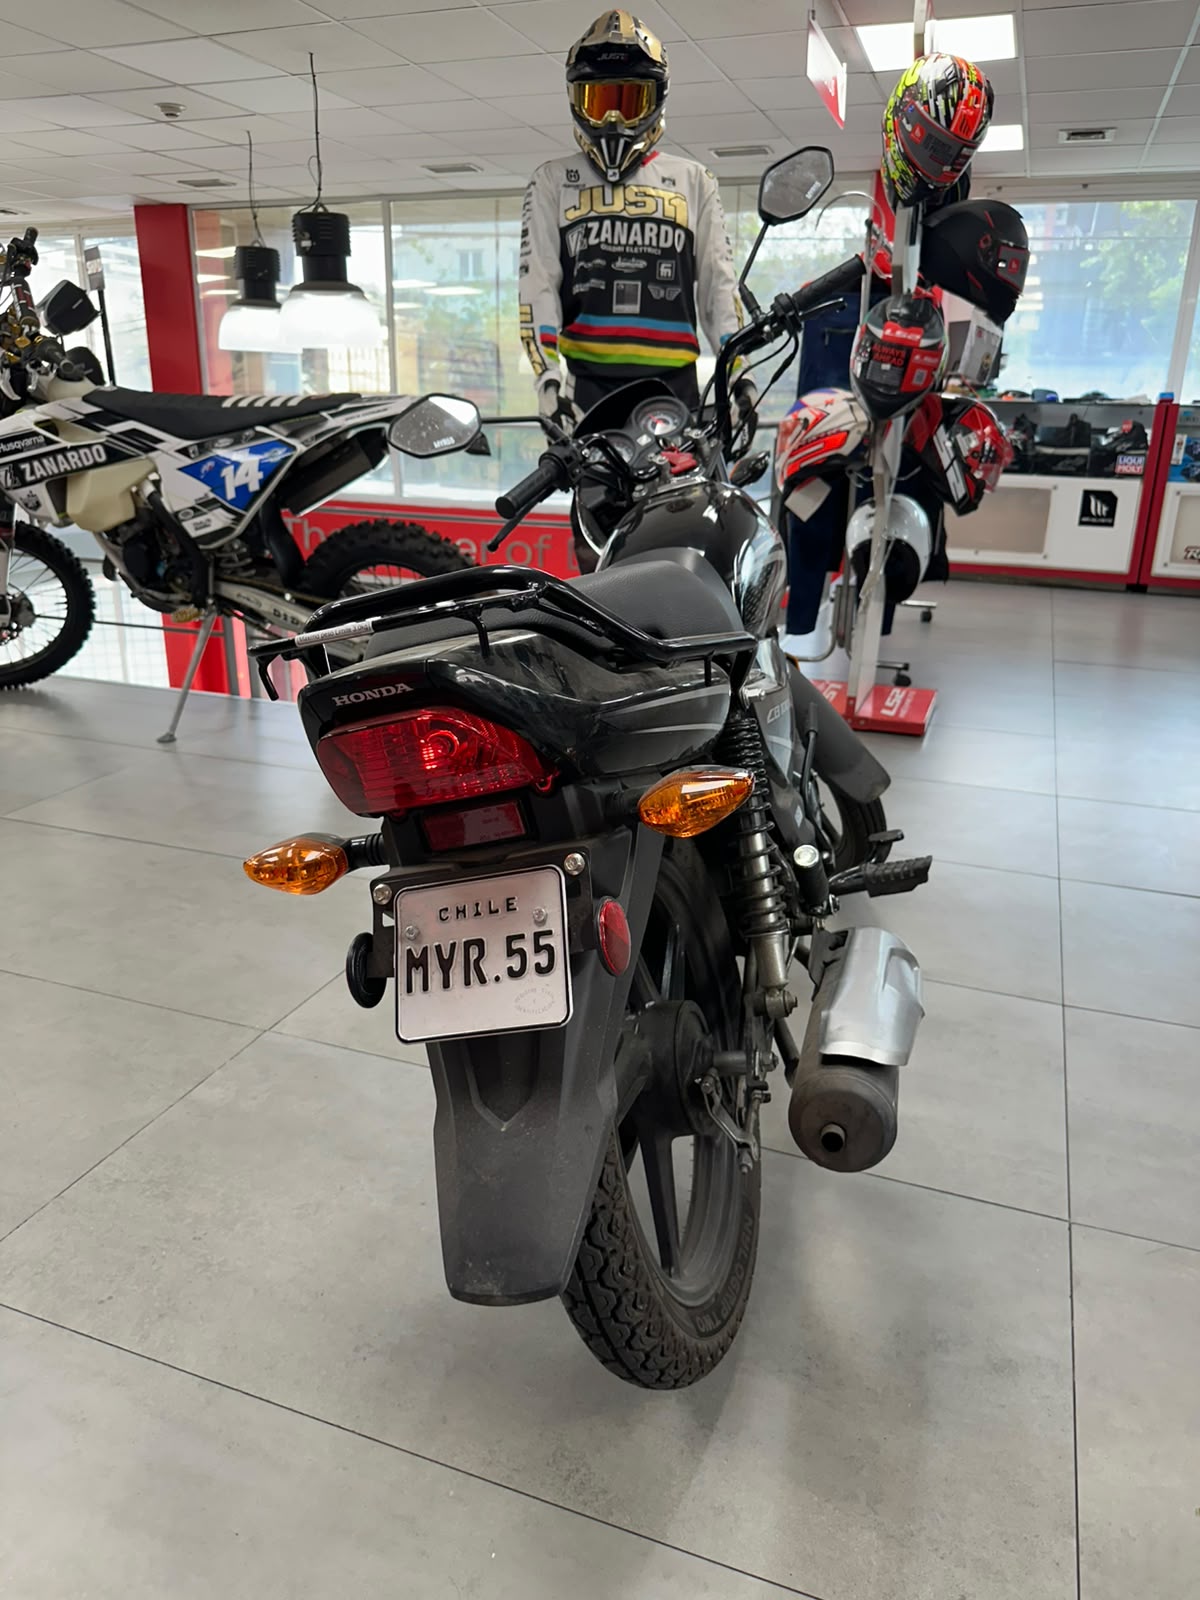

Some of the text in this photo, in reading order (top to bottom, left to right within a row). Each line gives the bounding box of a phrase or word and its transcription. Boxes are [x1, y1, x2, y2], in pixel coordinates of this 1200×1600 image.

[564, 184, 689, 229] JUST1
[587, 219, 686, 253] ZANARDO
[0, 434, 45, 453] Husqvarna
[20, 444, 107, 482] ZANARDO
[1116, 465, 1143, 474] MOLY
[1119, 455, 1144, 465] LIQUI
[220, 458, 264, 501] 14
[505, 534, 553, 568] of
[331, 683, 414, 707] HONDA
[880, 688, 907, 717] LS2
[438, 896, 519, 923] CHILE
[405, 929, 556, 994] MYR.55
